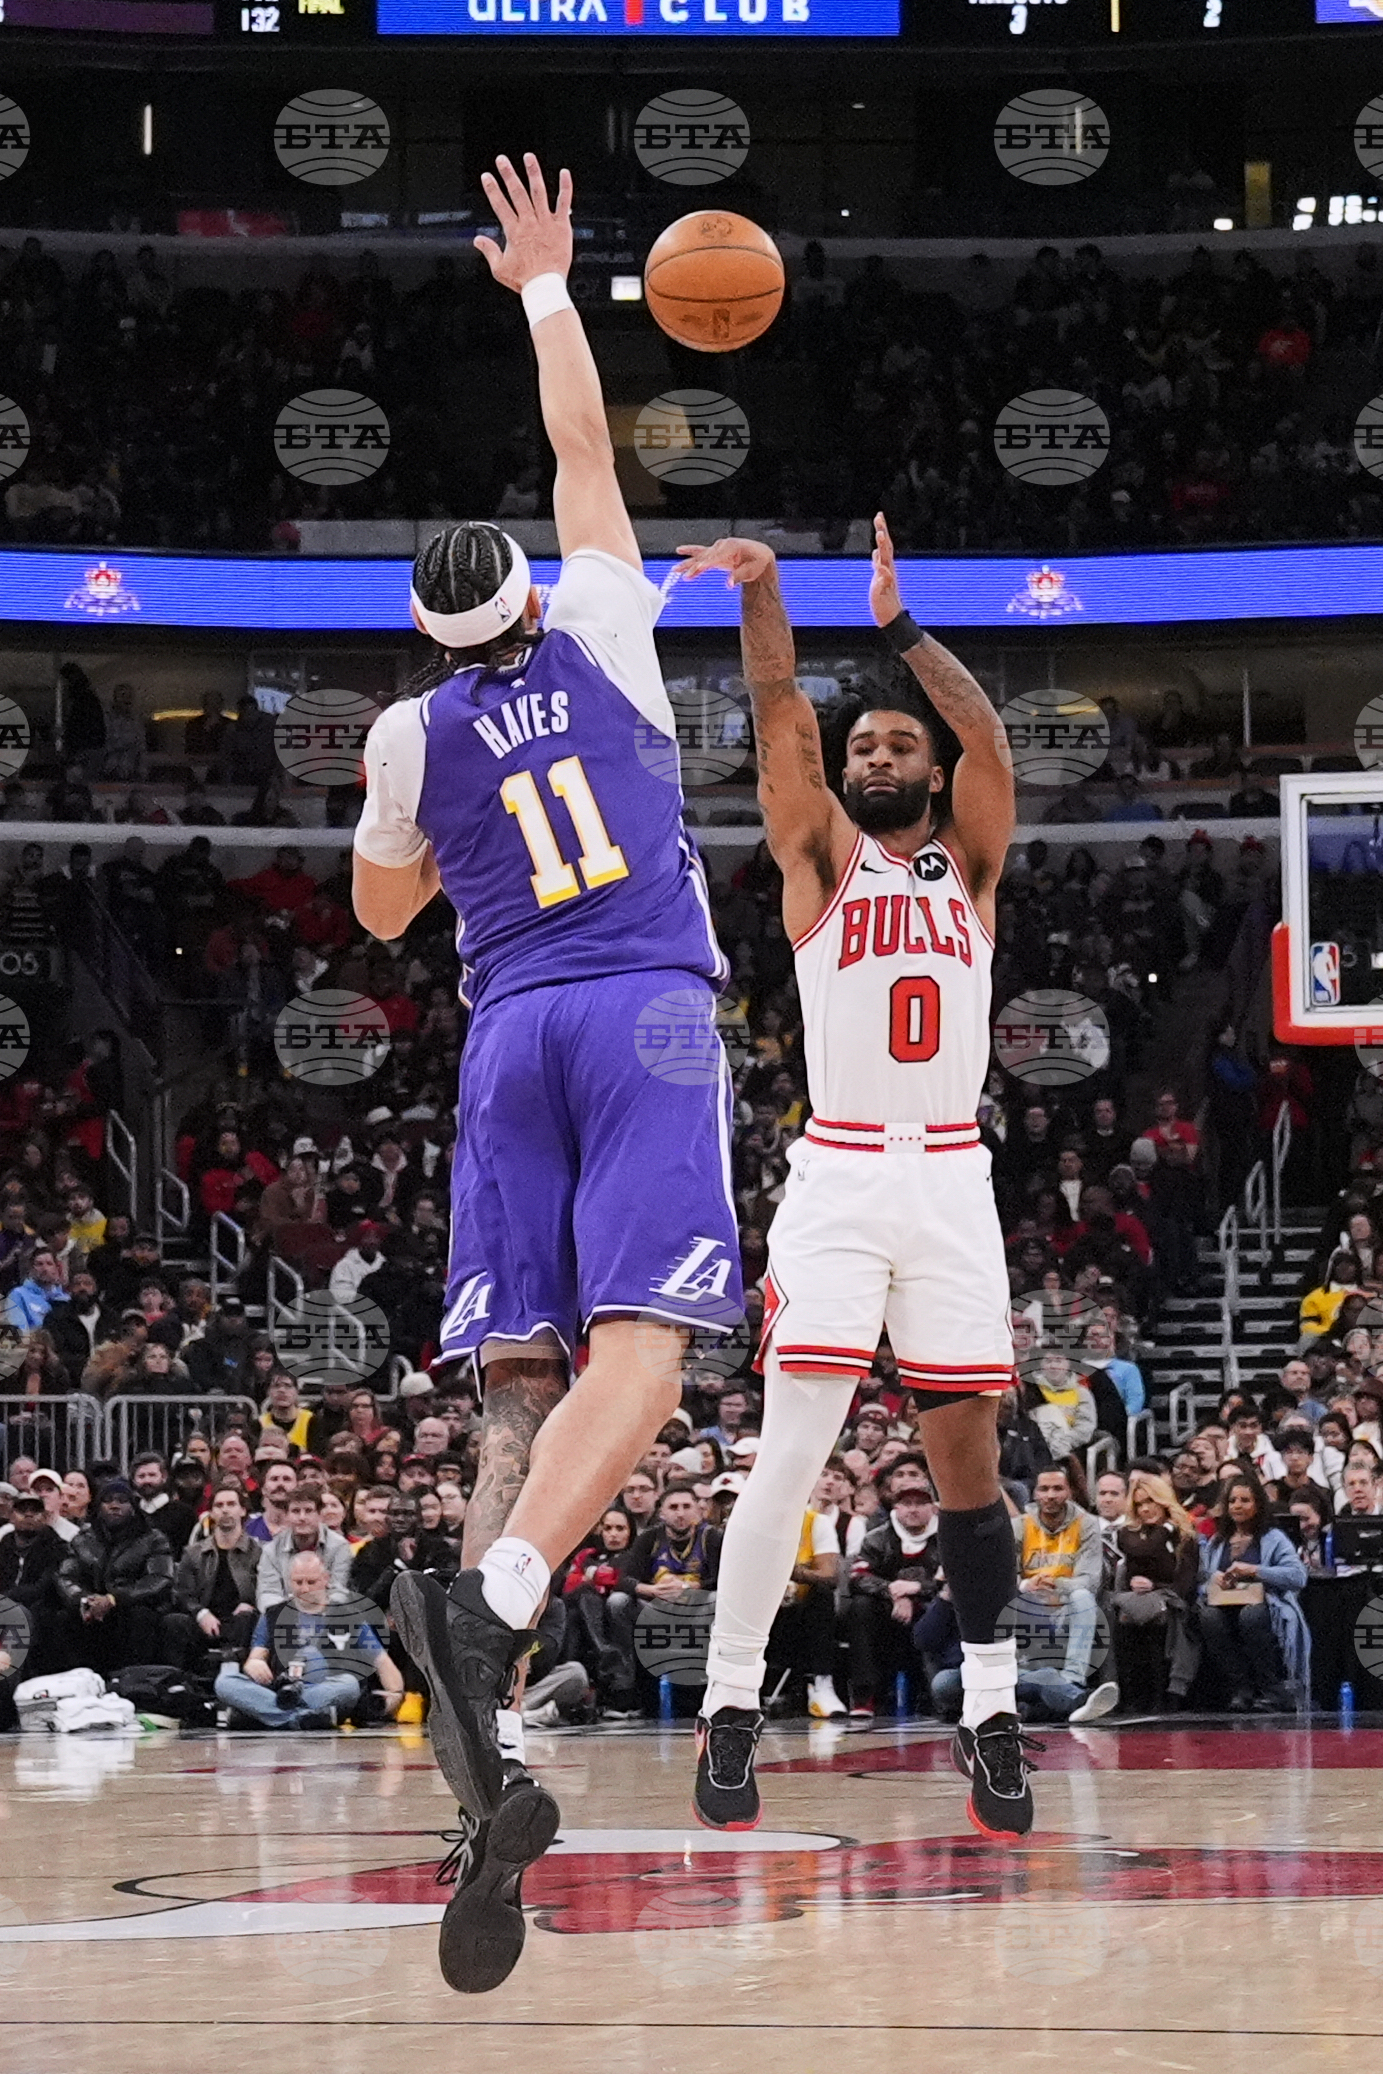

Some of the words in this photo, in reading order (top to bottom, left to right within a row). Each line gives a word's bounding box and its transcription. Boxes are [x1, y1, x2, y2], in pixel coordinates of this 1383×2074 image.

[241, 6, 280, 32] 132
[472, 690, 570, 760] HAYES
[499, 755, 630, 909] 11
[838, 894, 973, 971] BULLS
[888, 975, 941, 1064] 0
[648, 1236, 732, 1302] LA
